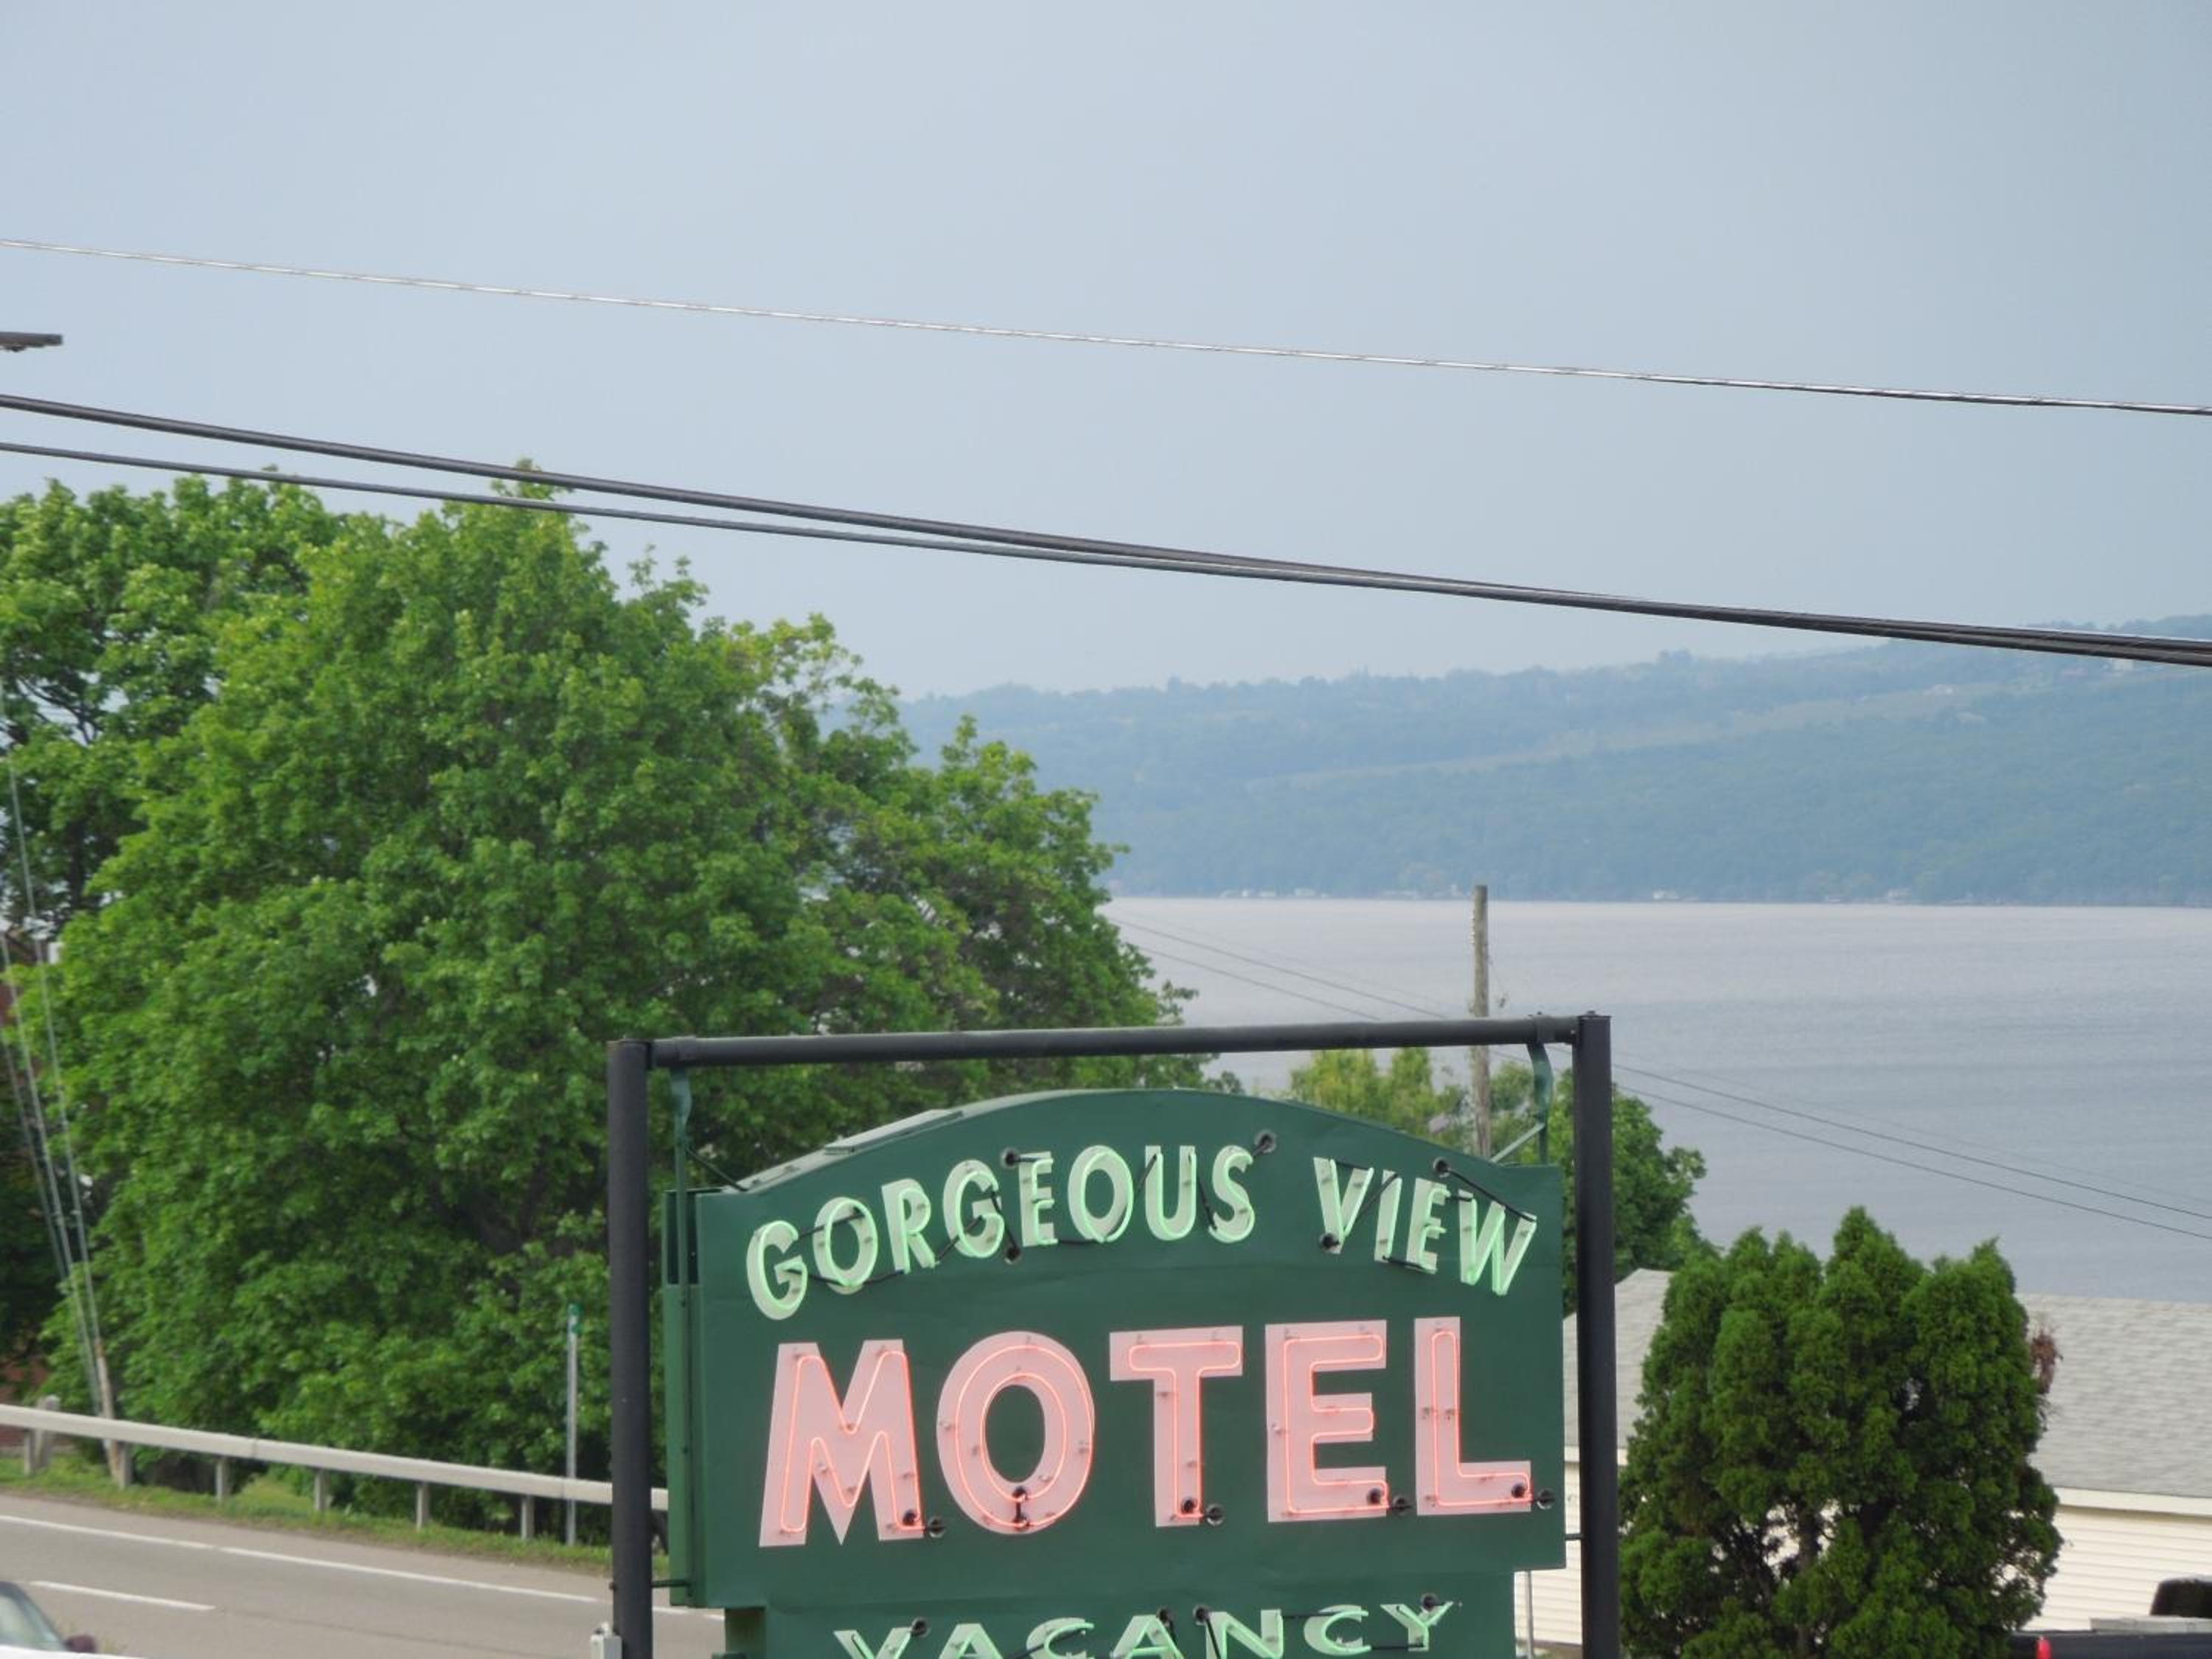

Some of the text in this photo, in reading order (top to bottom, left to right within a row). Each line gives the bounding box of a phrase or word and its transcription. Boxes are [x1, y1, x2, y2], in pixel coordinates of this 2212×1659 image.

[746, 1144, 1537, 1321] GORGEOUS VIEW
[759, 1316, 1532, 1547] MOTEL
[834, 1601, 1454, 1659] VACANCY
